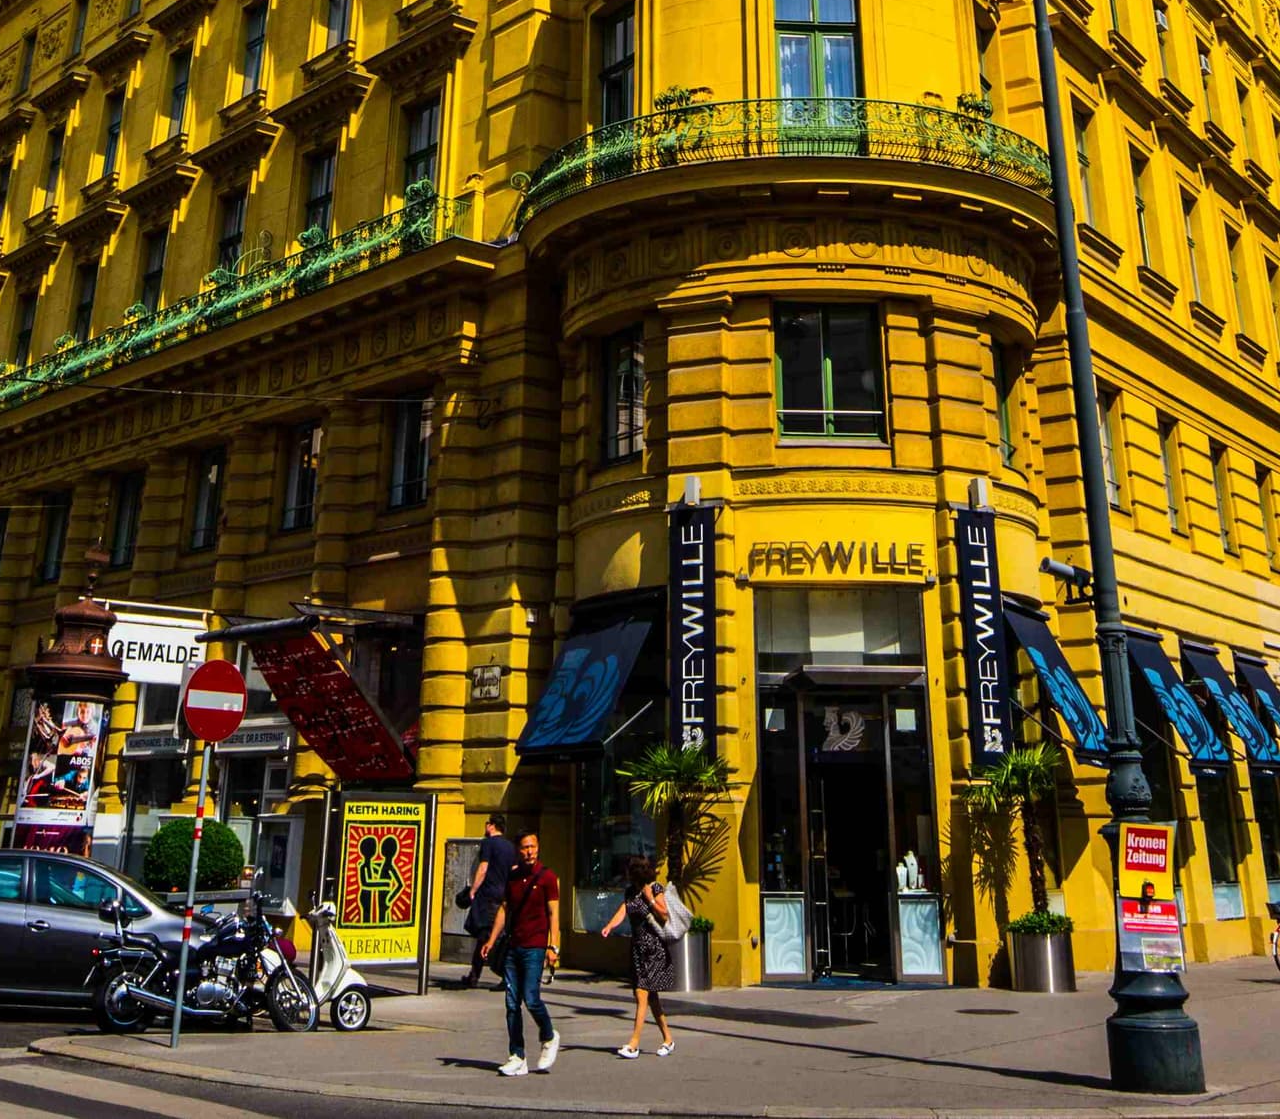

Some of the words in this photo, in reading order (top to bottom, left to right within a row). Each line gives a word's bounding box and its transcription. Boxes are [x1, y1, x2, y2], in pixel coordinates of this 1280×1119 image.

[750, 541, 925, 574] FREYWILLE
[681, 523, 705, 723] FREYWILLE
[967, 525, 1002, 725] FREYWILLE
[112, 640, 200, 664] GEMÄLDE
[70, 756, 92, 765] ABOS
[348, 805, 379, 815] KEITH
[381, 806, 420, 816] HARING
[1127, 832, 1166, 850] Kronen
[1127, 848, 1166, 867] Zeitung
